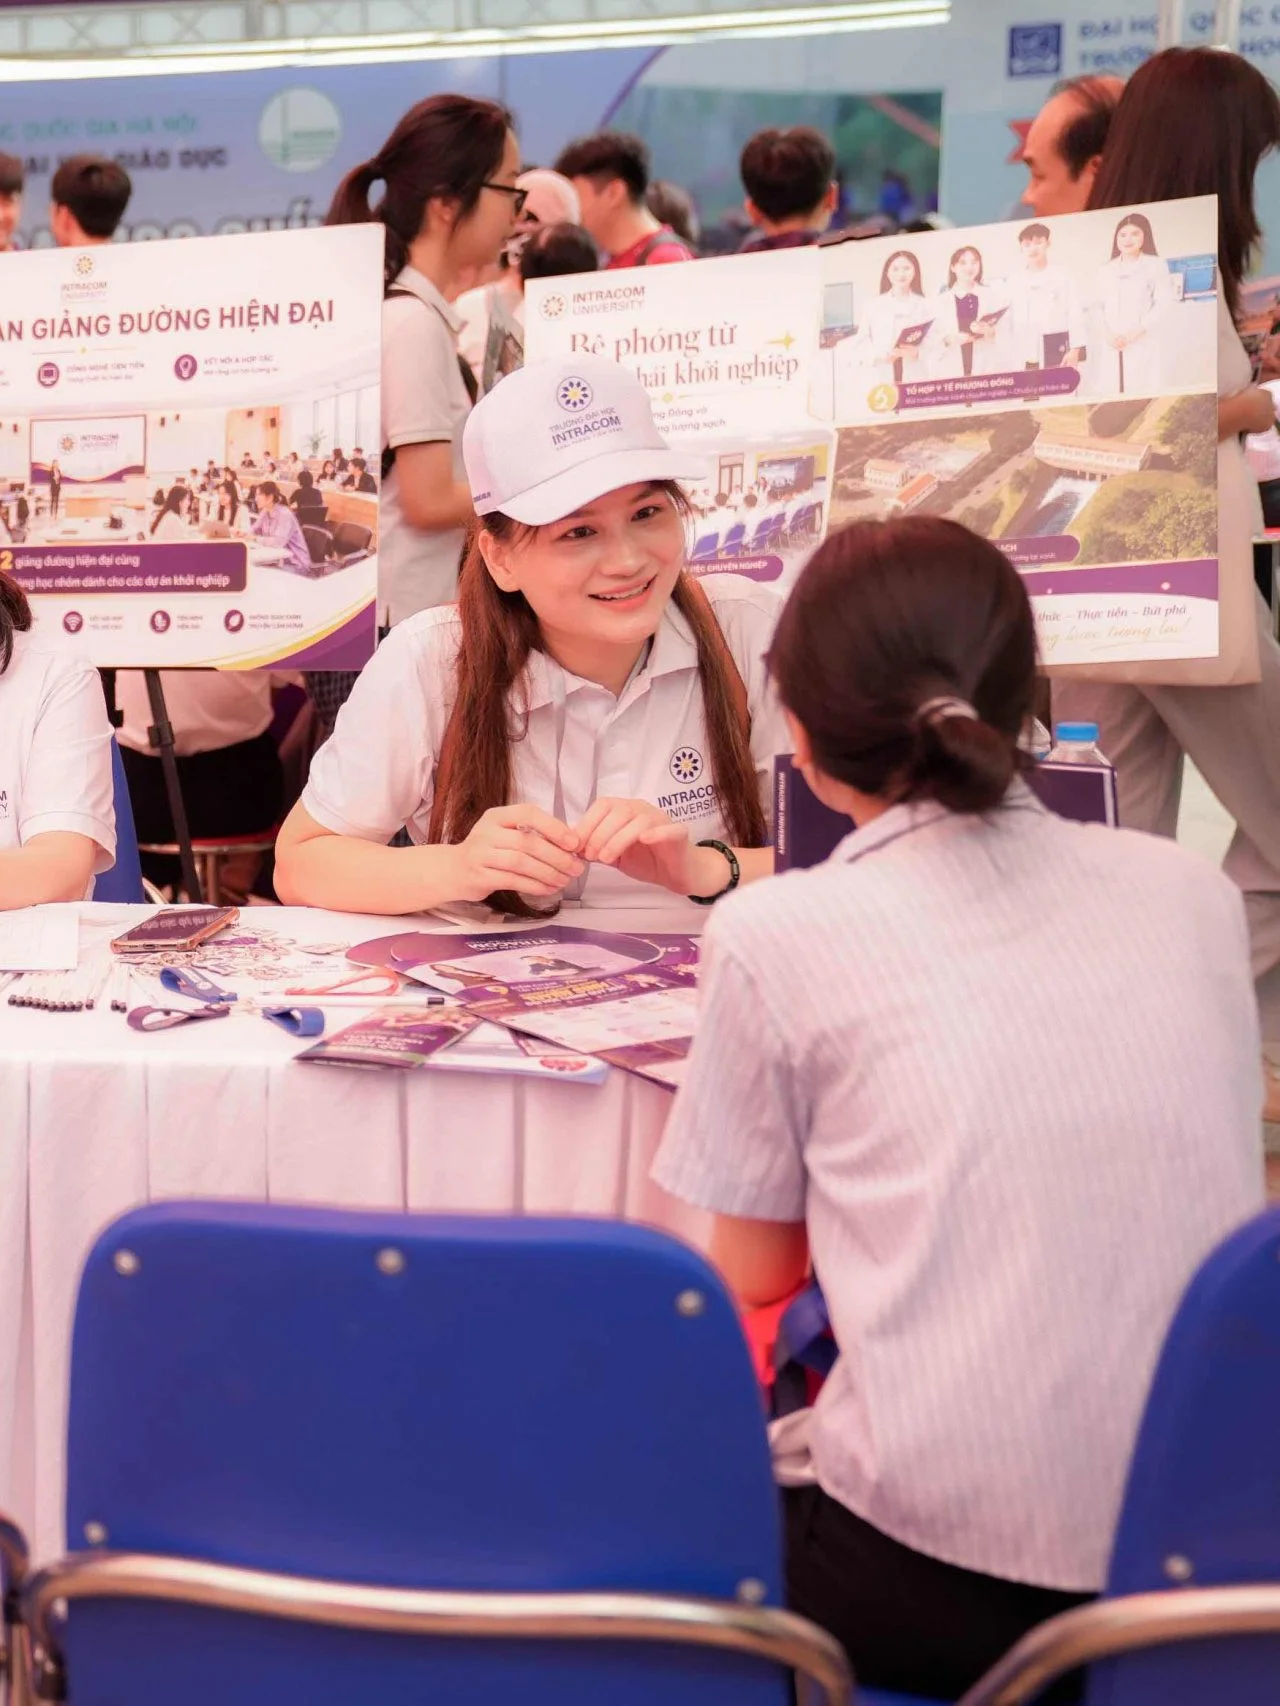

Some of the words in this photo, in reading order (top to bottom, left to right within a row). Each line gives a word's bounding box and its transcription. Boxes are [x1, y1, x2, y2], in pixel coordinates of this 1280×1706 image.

[572, 286, 645, 304] INTRACOM
[572, 299, 645, 316] UNIVERSITY
[31, 309, 111, 341] GIẢNG
[118, 304, 211, 335] ĐƯỜNG
[219, 298, 280, 333] HIỆN
[287, 299, 334, 330] ĐẠI
[615, 326, 701, 363] phóng
[708, 320, 738, 348] từ
[675, 359, 719, 385] khởi
[728, 353, 799, 388] nghiệp
[552, 415, 622, 446] INTRACOM
[14, 555, 43, 569] giảng
[44, 554, 75, 569] đường
[76, 554, 97, 568] hiện
[98, 553, 114, 567] đại
[115, 553, 140, 568] cùng
[36, 576, 53, 590] học
[54, 575, 80, 588] nhóm
[81, 575, 106, 588] dành
[107, 575, 126, 588] cho
[126, 574, 143, 587] các
[144, 574, 159, 588] dự
[159, 573, 172, 587] án
[173, 573, 195, 587] khởi
[195, 572, 231, 589] nghiệp
[658, 785, 714, 809] INTRACO
[666, 796, 719, 818] NIVERSIT
